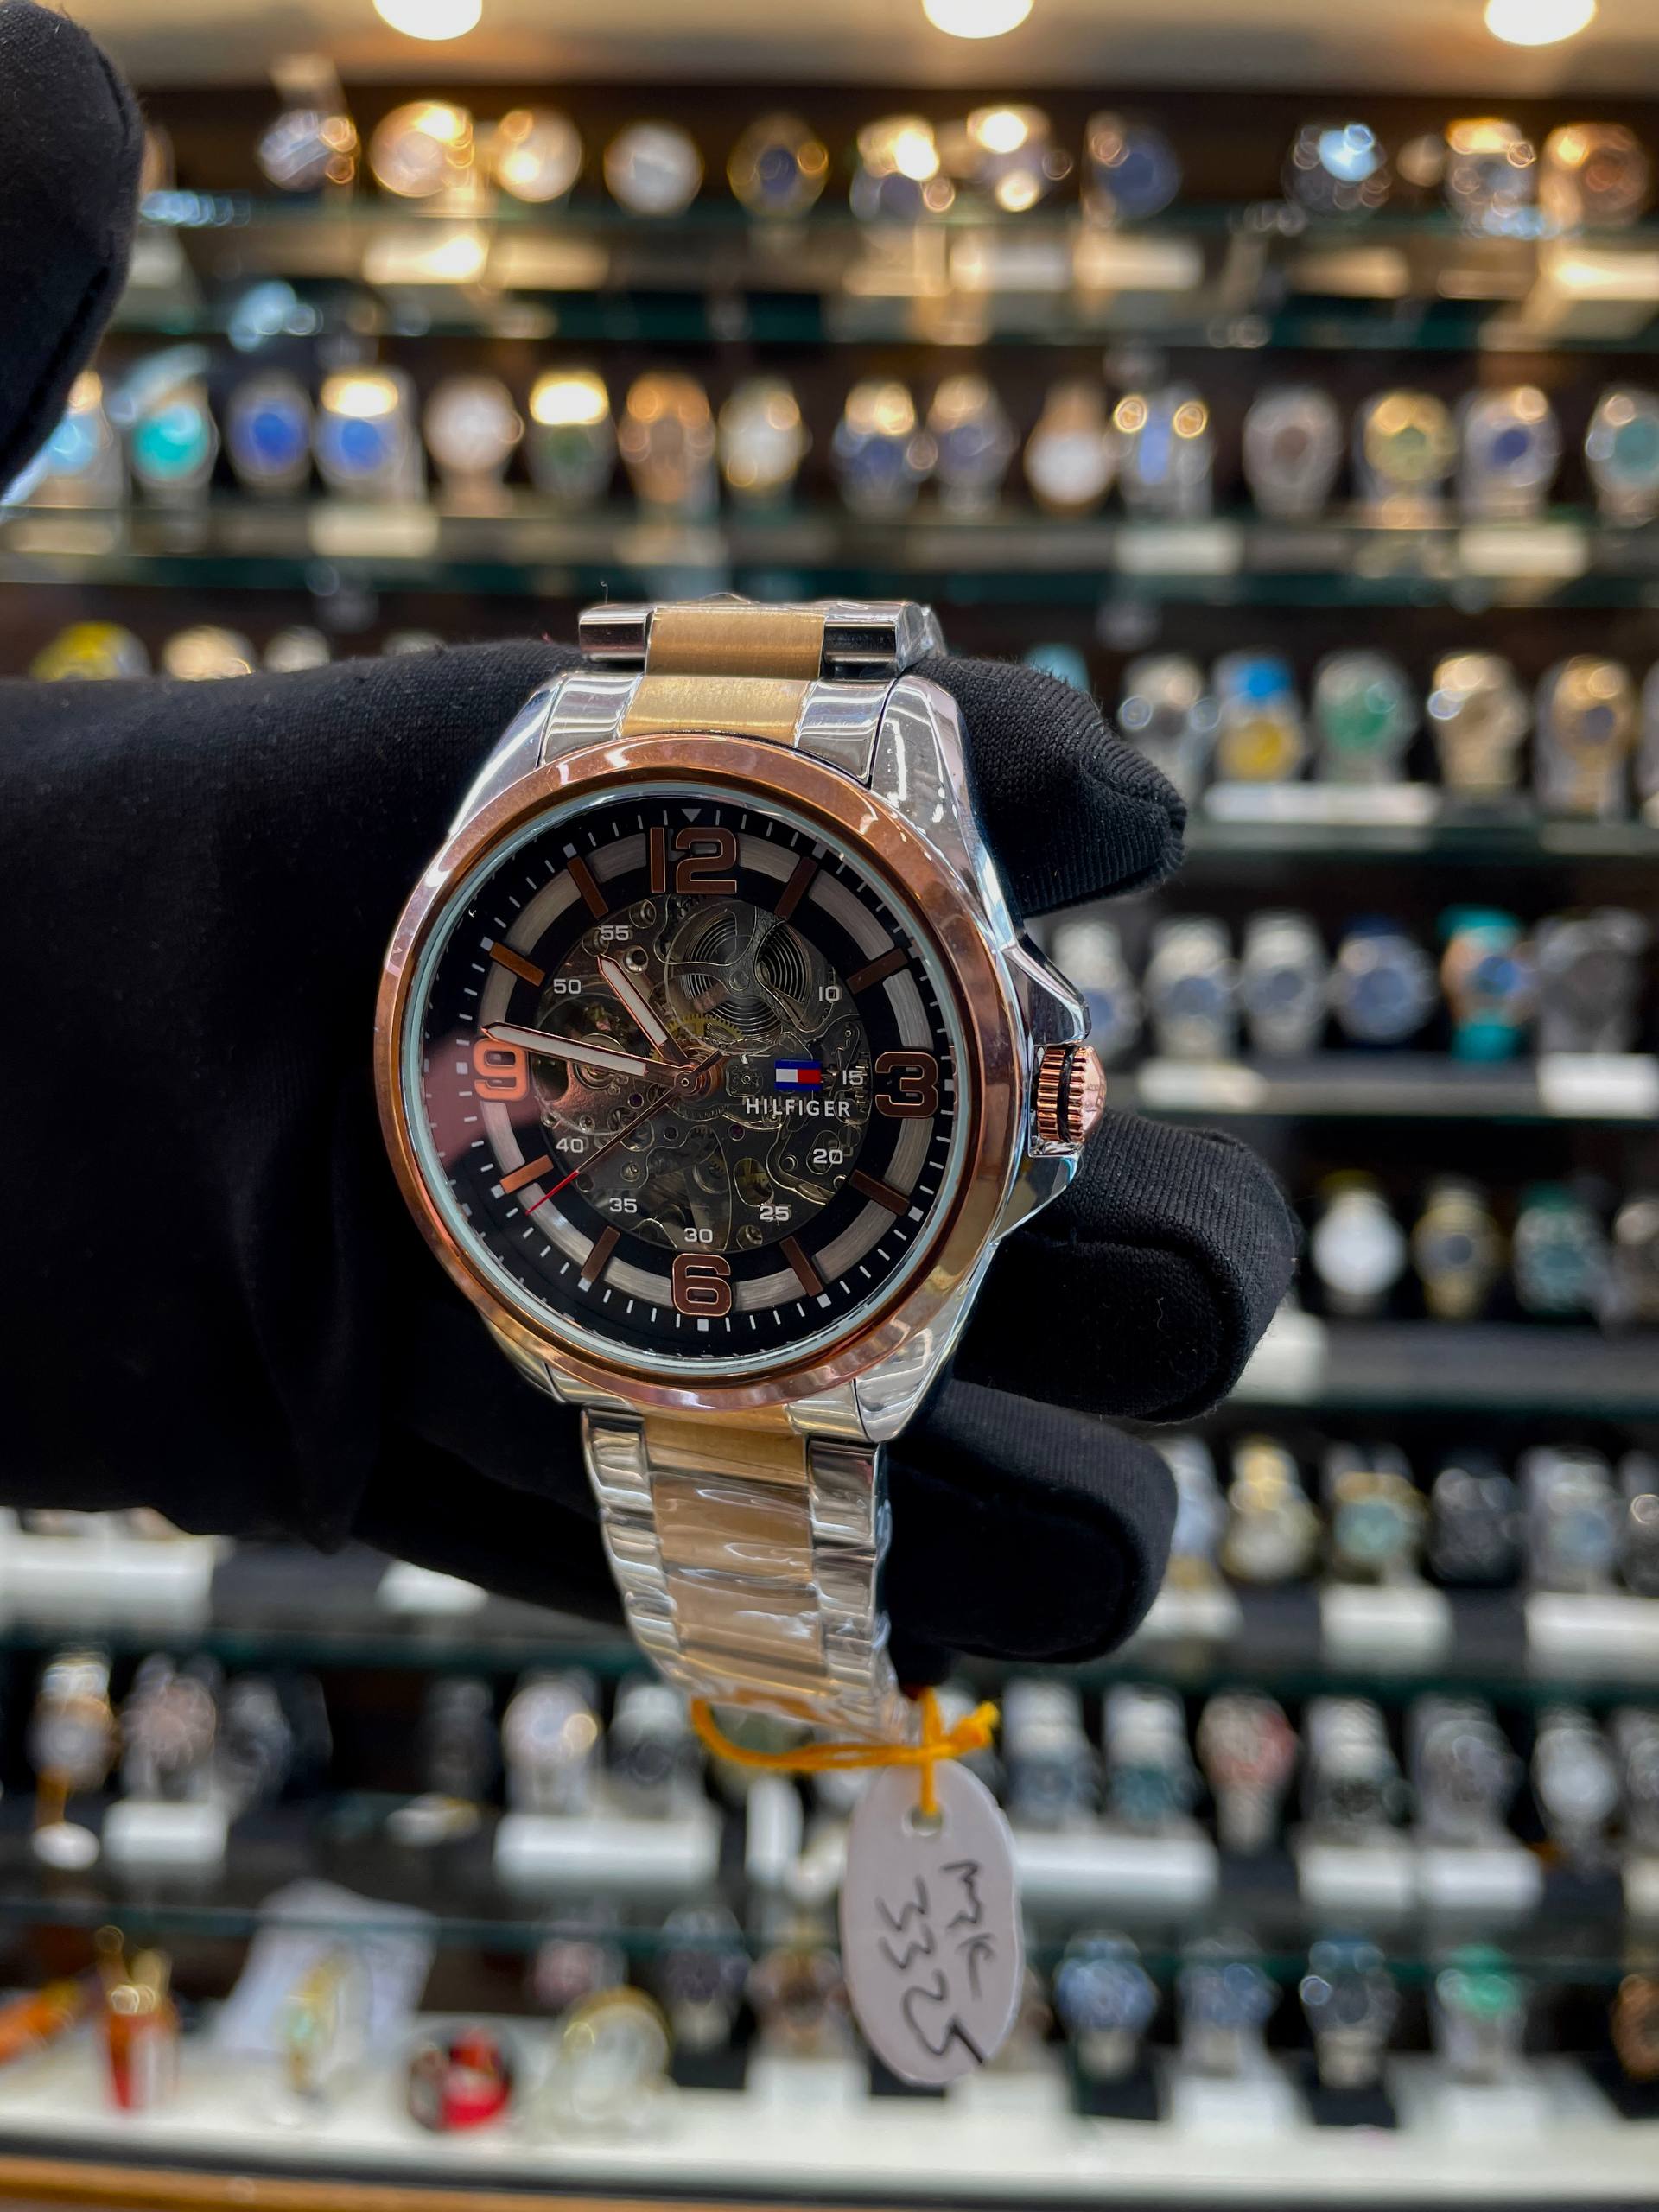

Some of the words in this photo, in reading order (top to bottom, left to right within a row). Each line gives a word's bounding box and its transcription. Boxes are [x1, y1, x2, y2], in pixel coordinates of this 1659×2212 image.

[650, 827, 737, 894] 12
[601, 925, 629, 941] 55
[553, 979, 582, 995] 50
[818, 986, 840, 1002] 10
[473, 1038, 530, 1102] 9
[842, 1070, 864, 1085] 15
[874, 1051, 938, 1118] 3
[746, 1097, 851, 1118] HILFIGER
[556, 1138, 585, 1153] 40
[813, 1148, 843, 1165] 20
[609, 1198, 638, 1213] 35
[760, 1205, 790, 1222] 25
[683, 1227, 713, 1243] 30
[672, 1253, 732, 1317] 6
